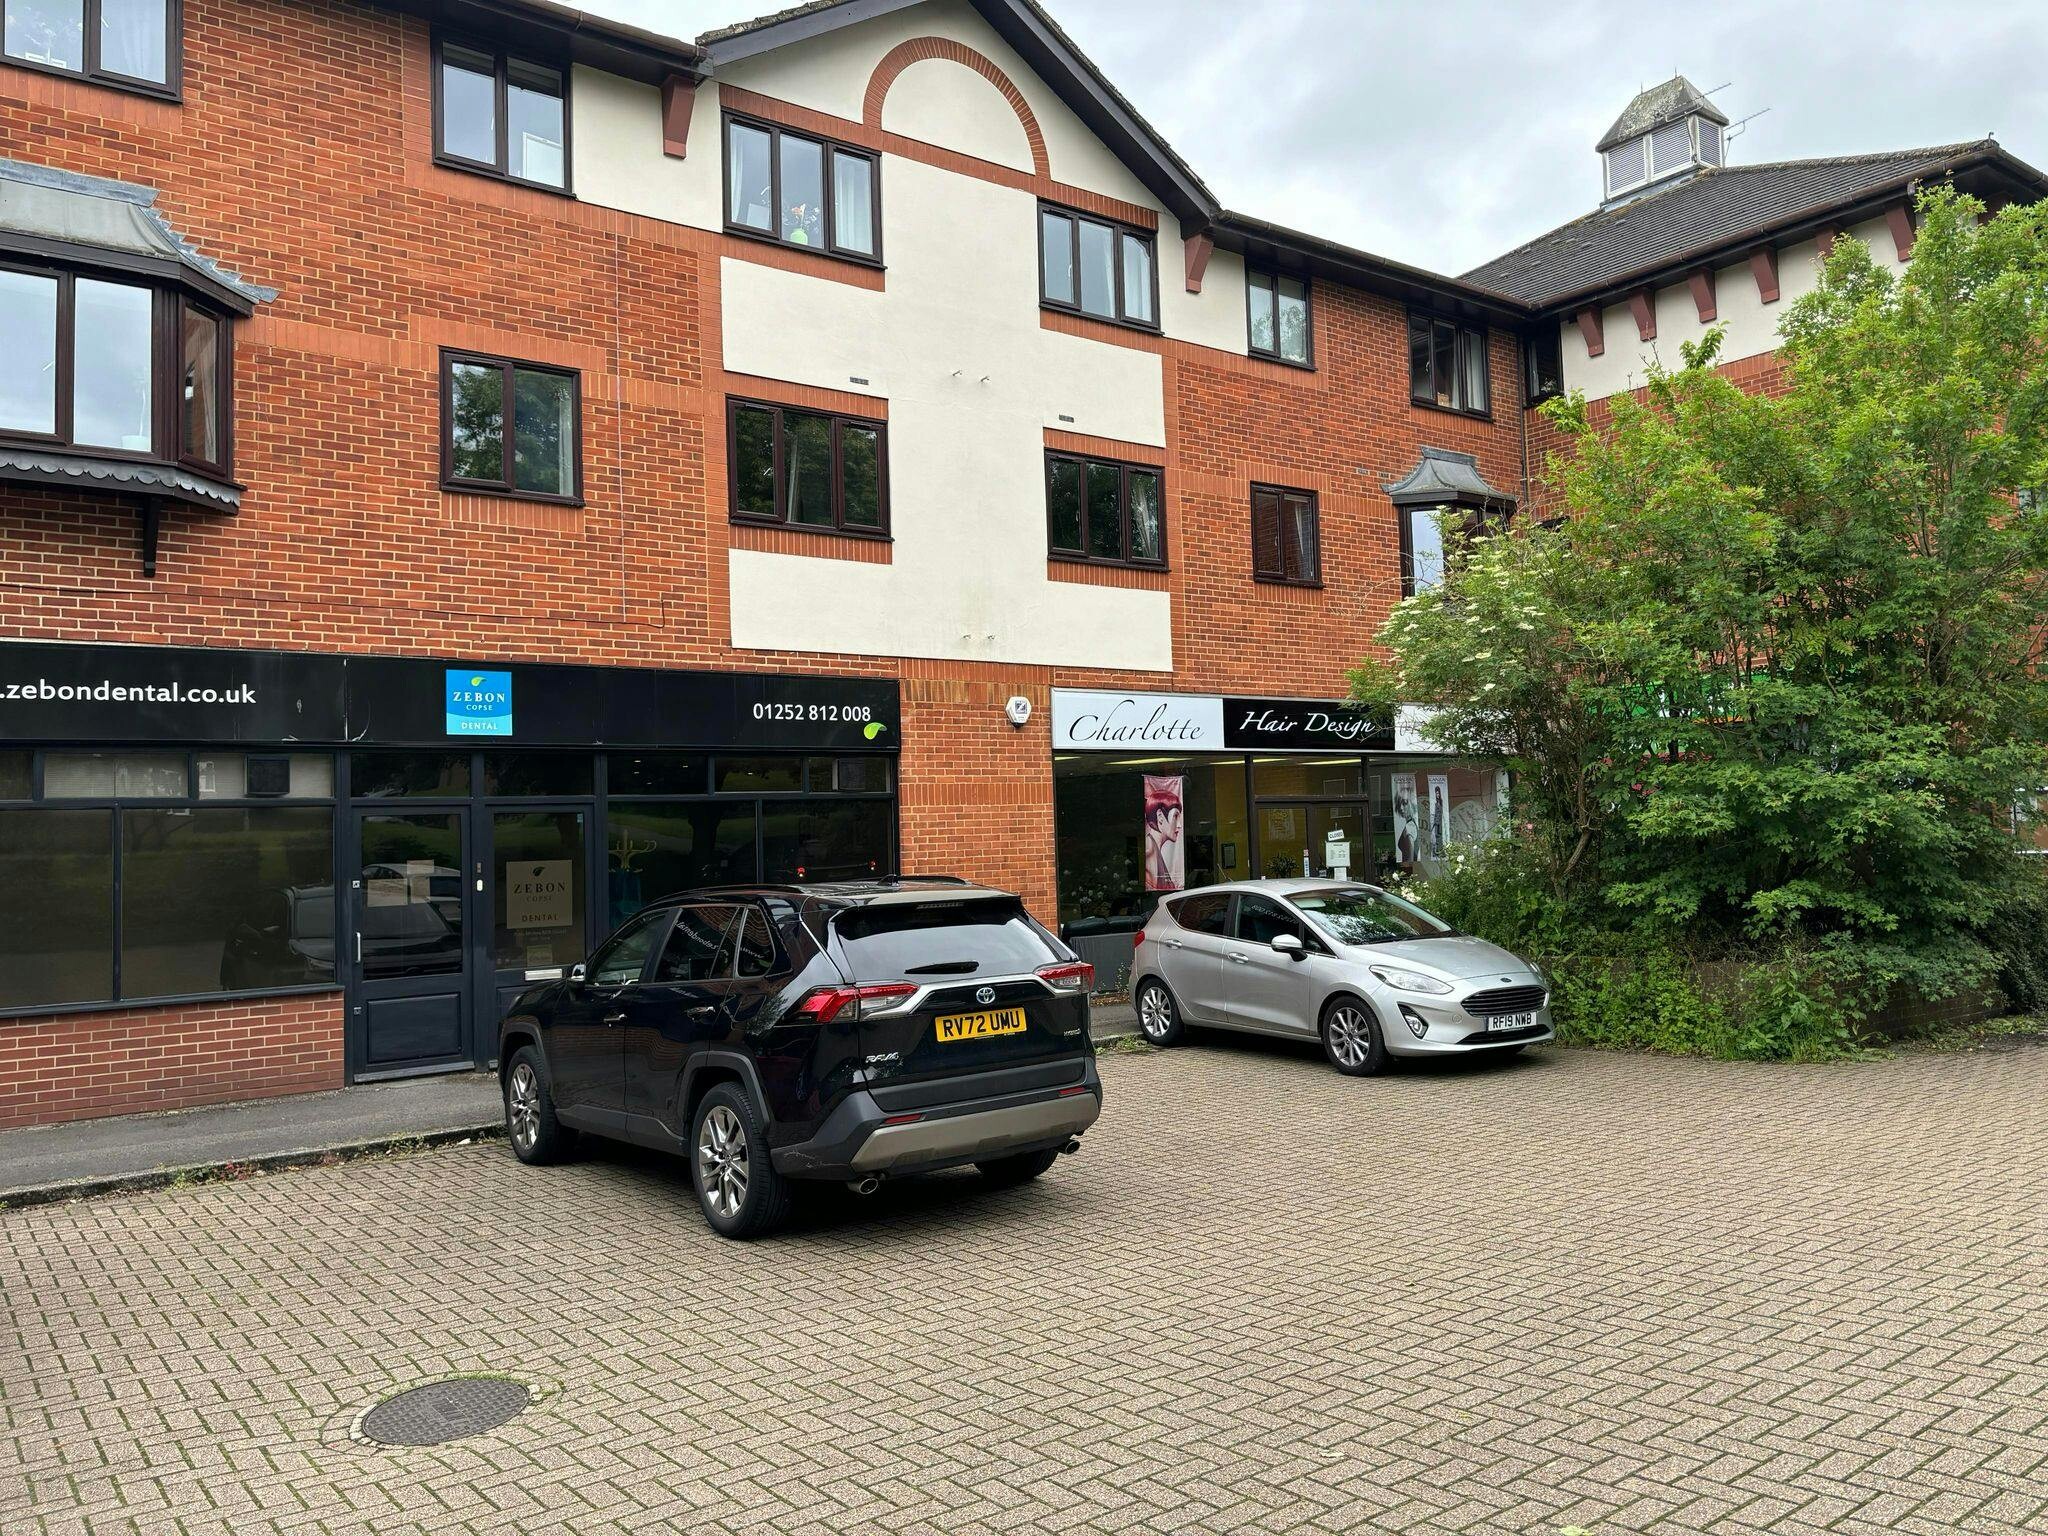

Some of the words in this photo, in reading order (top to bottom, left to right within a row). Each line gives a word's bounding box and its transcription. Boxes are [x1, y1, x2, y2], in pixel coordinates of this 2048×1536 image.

[453, 691, 505, 703] ZEBON
[753, 703, 804, 720] 01252
[808, 705, 838, 721] 812
[842, 706, 871, 722] 008
[1069, 699, 1205, 742] Charlotte
[461, 721, 498, 730] DENTAL
[1239, 709, 1298, 733] Hair
[1304, 712, 1376, 740] Design
[513, 882, 567, 894] ZEBON
[521, 914, 559, 922] DENTAL
[943, 1014, 987, 1038] RV72
[990, 1010, 1020, 1031] UMU
[1493, 1015, 1513, 1029] RF19
[1515, 1013, 1532, 1026] NWB
